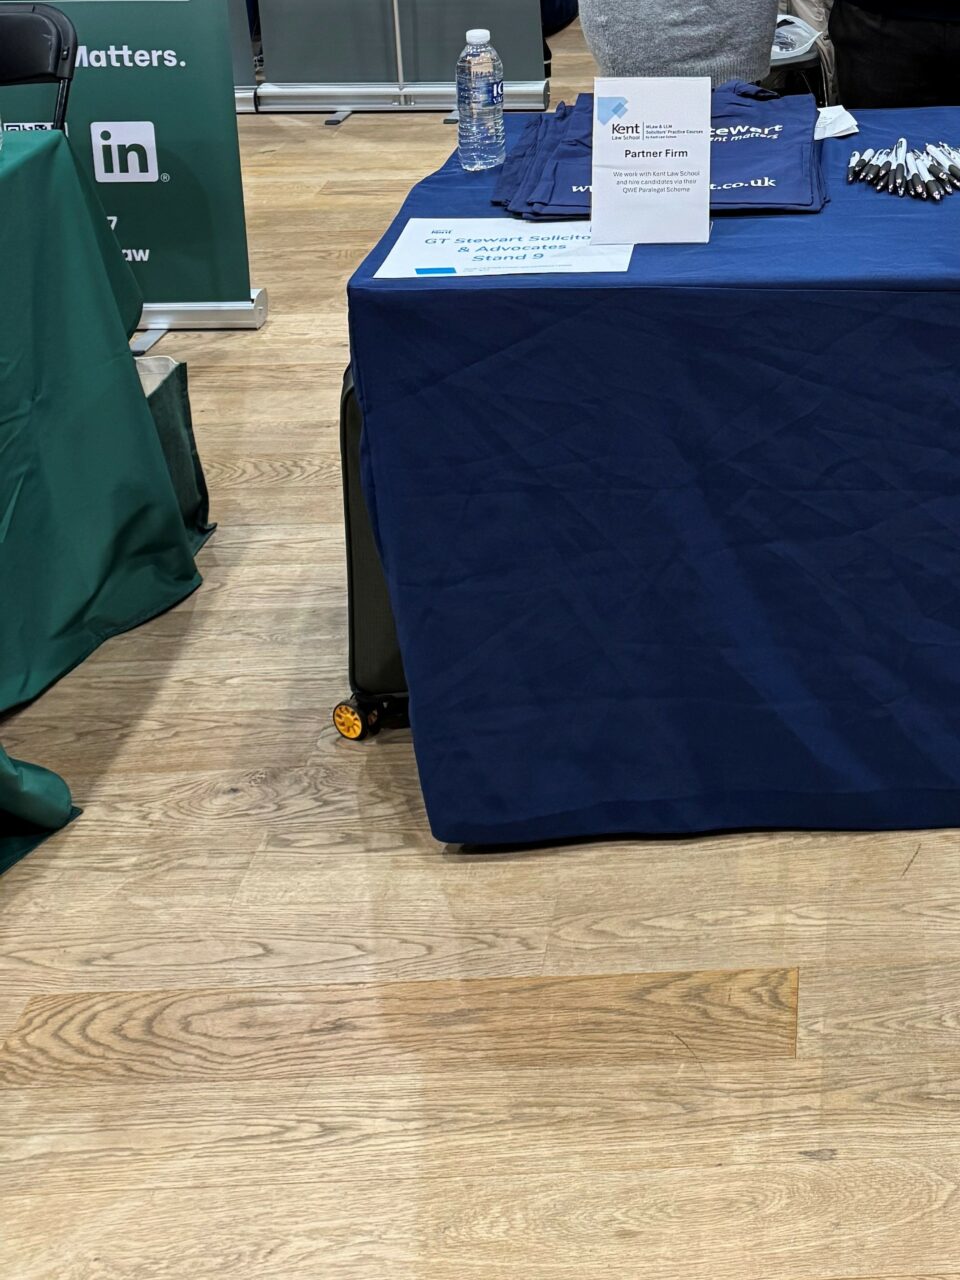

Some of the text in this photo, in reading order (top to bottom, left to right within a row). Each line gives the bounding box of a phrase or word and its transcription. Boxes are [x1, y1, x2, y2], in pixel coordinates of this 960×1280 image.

[612, 123, 640, 135] Kent
[625, 149, 688, 158] Partner Firm
[454, 236, 523, 244] Stewart
[476, 244, 567, 252] Advocates
[472, 254, 527, 262] Stand
